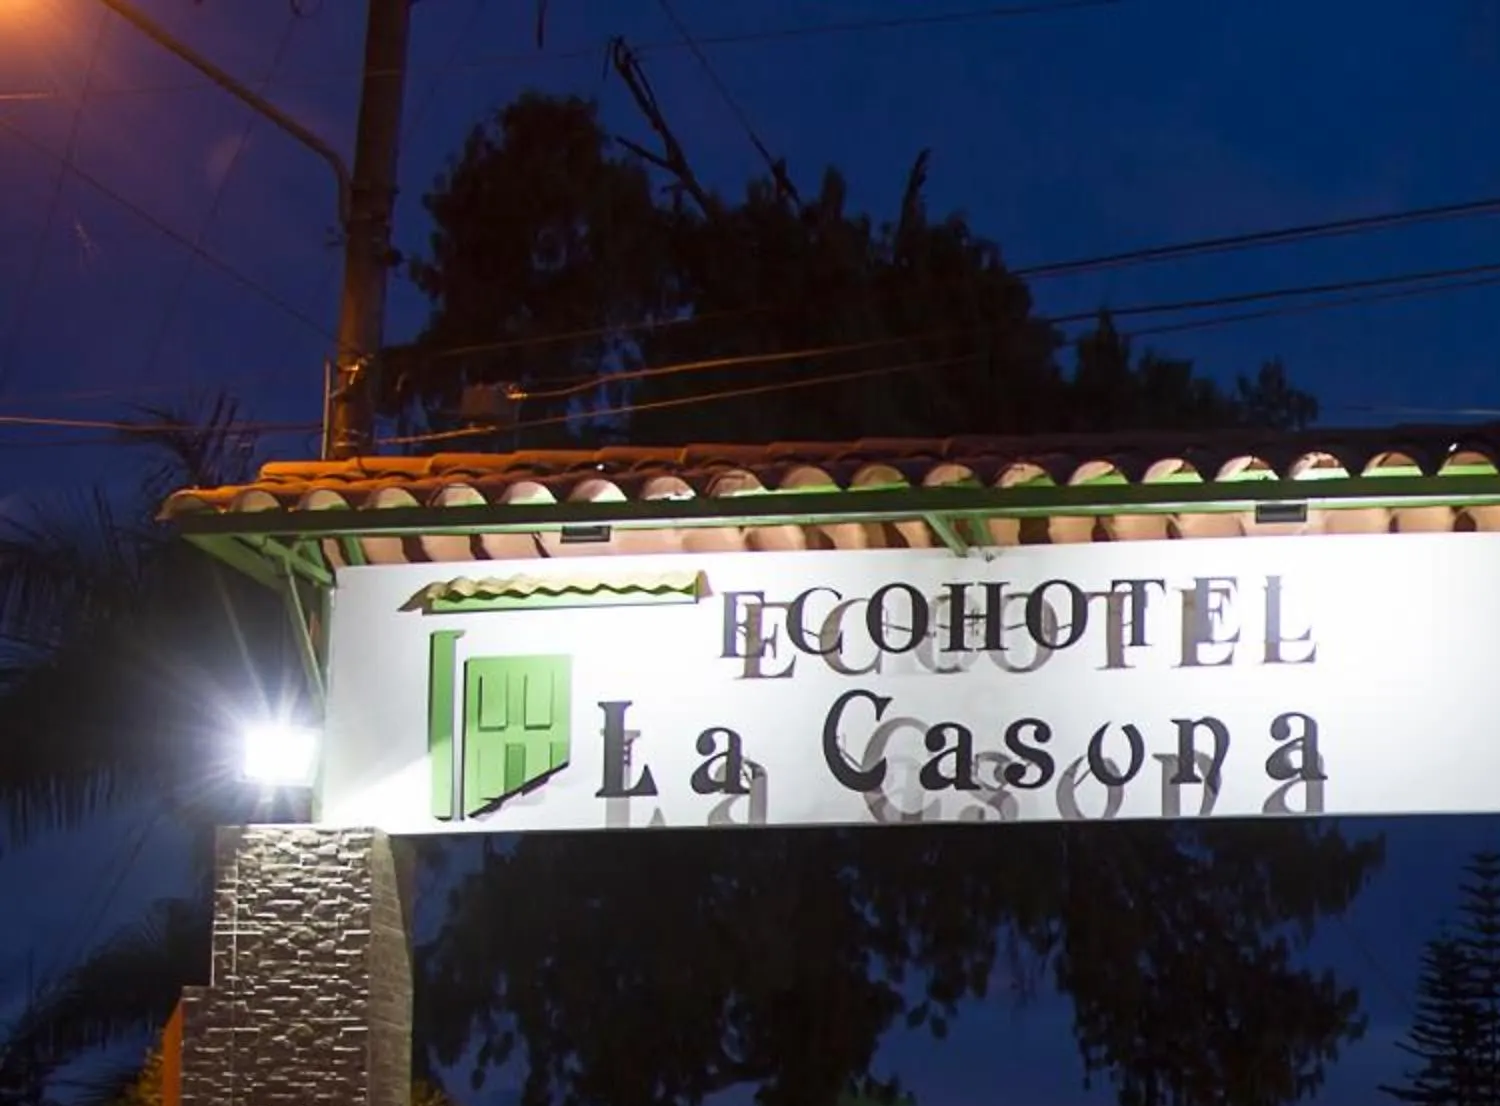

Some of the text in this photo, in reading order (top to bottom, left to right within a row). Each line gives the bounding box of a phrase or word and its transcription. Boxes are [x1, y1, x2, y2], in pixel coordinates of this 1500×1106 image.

[719, 574, 1312, 659] ECOHOTEL
[594, 689, 1328, 798] La Casona
